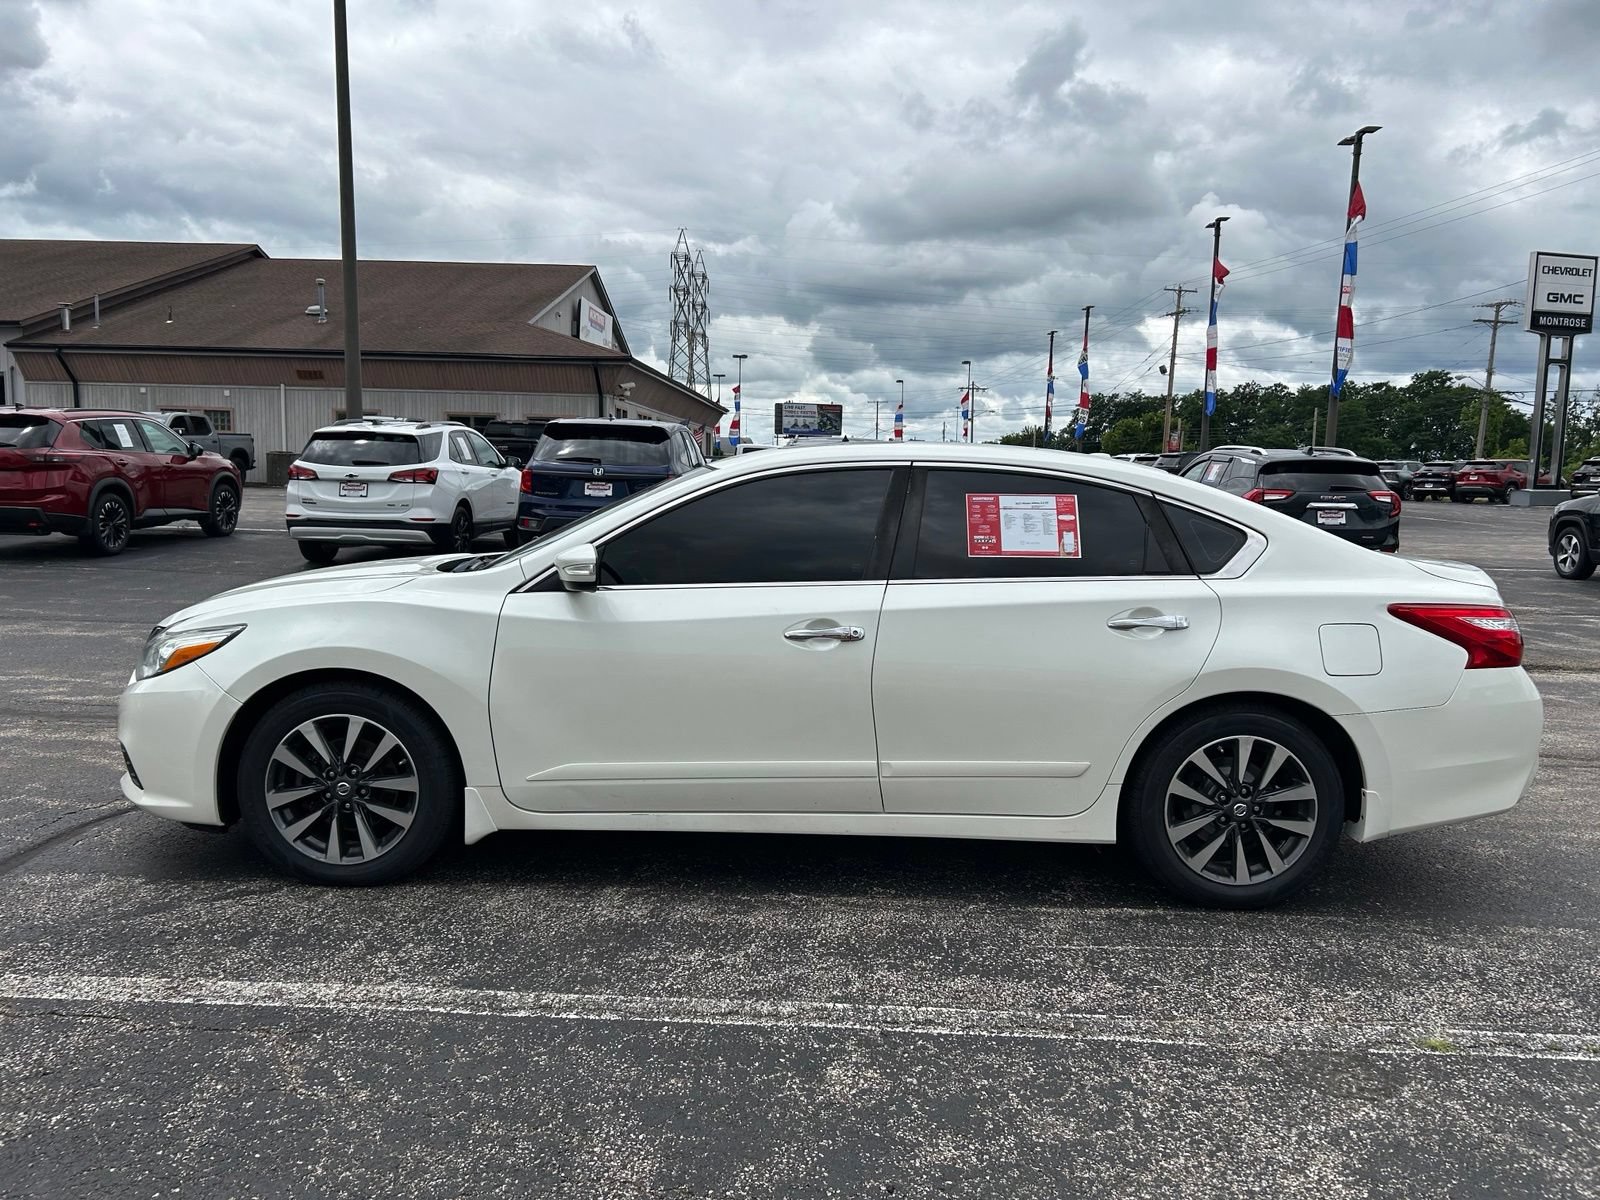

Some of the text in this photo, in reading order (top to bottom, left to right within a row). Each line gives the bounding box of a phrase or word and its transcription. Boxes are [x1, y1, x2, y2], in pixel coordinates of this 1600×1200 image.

[1542, 265, 1593, 277] CHEVROLET
[1546, 292, 1584, 304] GMC
[1539, 316, 1587, 328] MONTROSE
